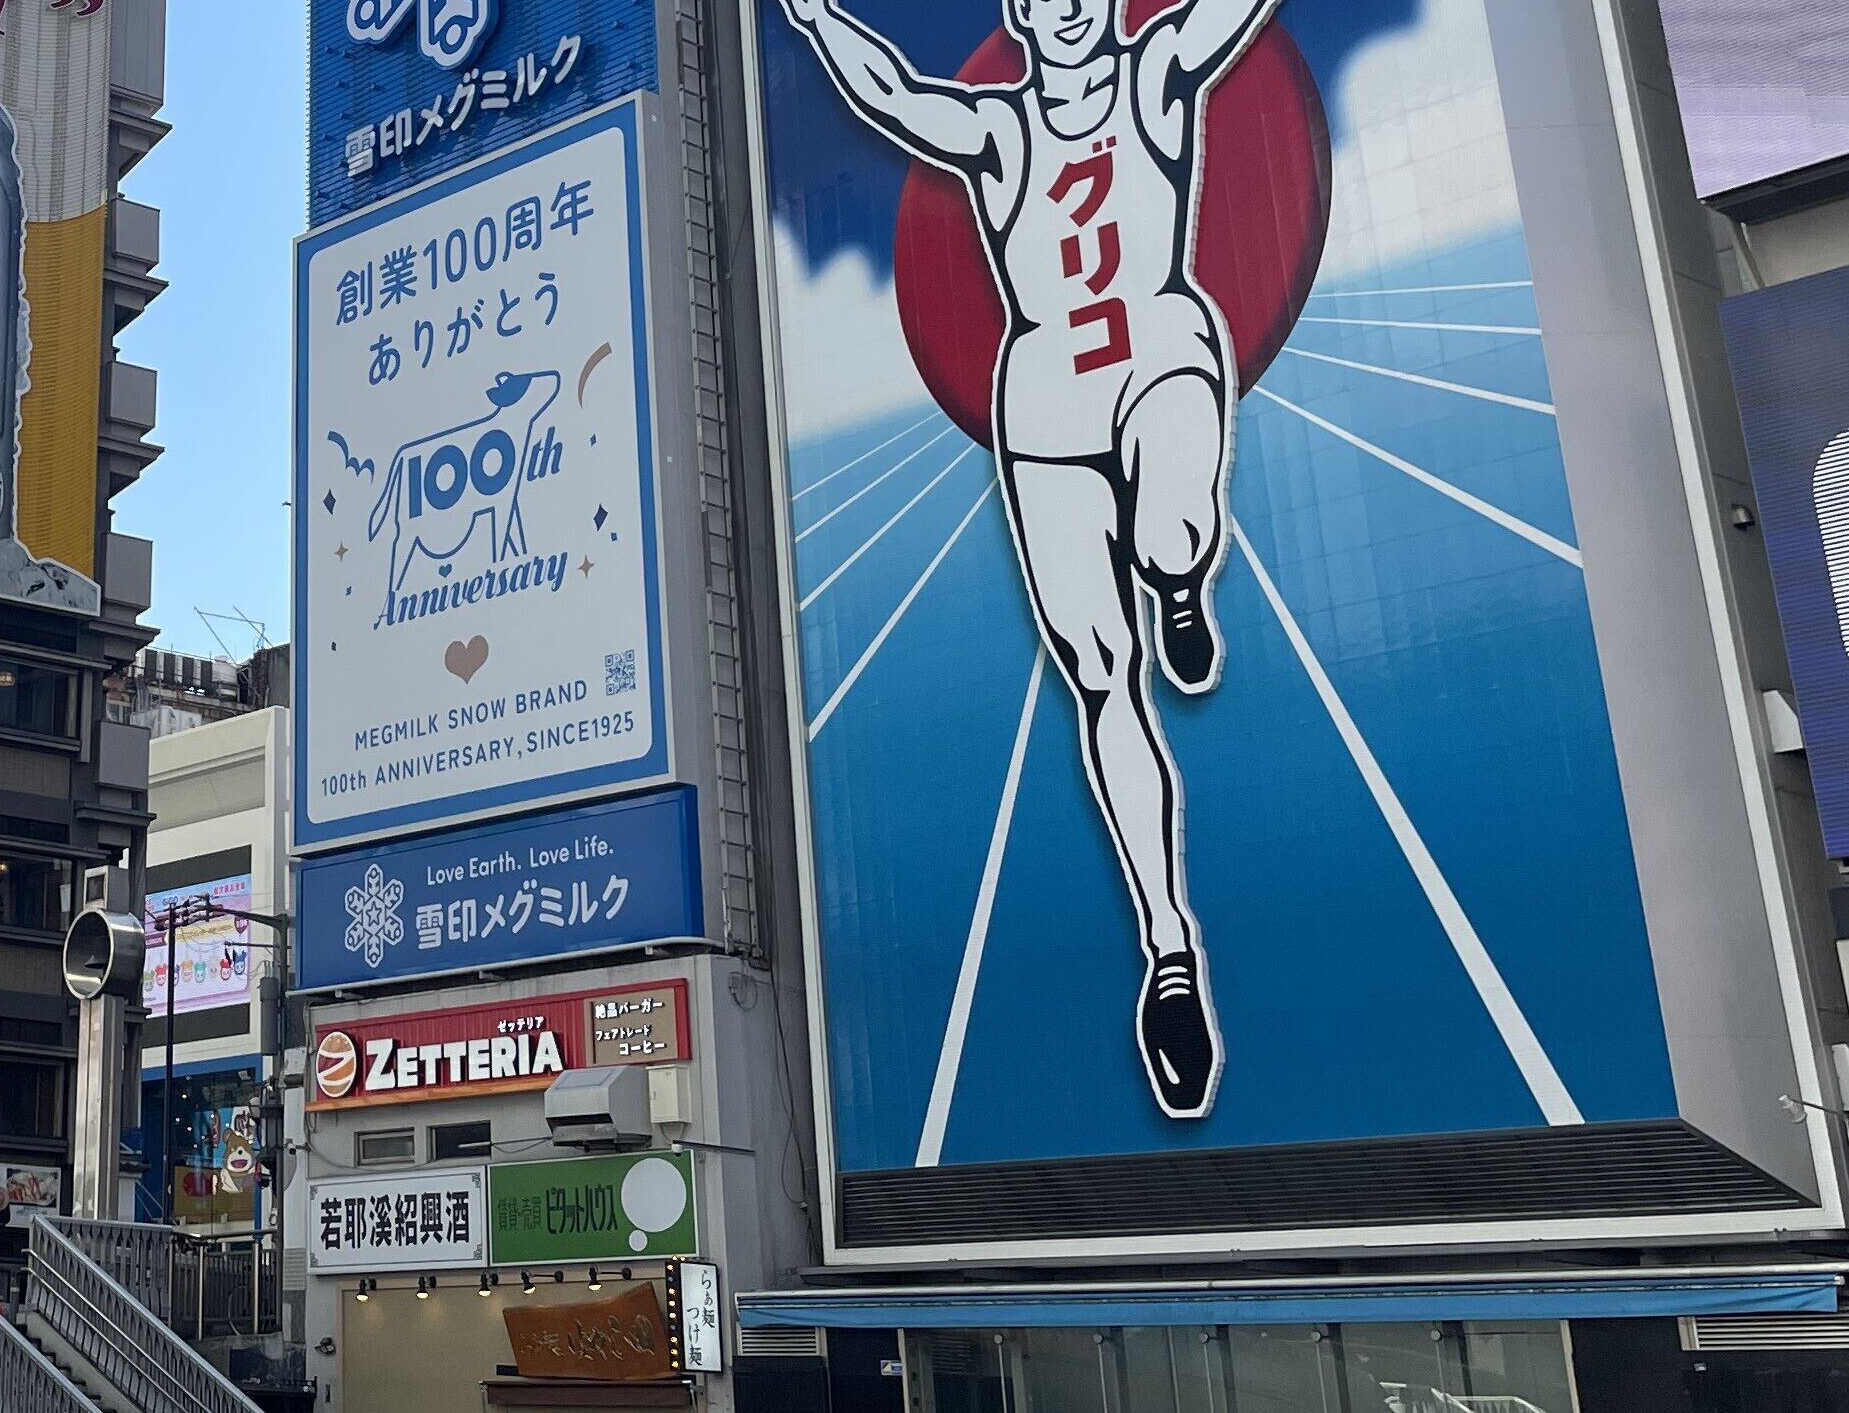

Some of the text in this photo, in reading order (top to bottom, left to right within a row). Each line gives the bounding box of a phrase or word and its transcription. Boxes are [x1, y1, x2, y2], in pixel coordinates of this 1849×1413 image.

[345, 34, 582, 178] 雪印メグミルク
[335, 179, 594, 326] 創業100周年
[1046, 135, 1133, 375] グリコ
[367, 271, 559, 385] ありがとう
[408, 426, 563, 519] 100th
[373, 551, 568, 631] Anniversary
[354, 679, 588, 752] MEGMILK SNOW BRAND
[322, 769, 367, 797] 100th
[427, 835, 614, 887] Love Earth. Love Life.
[415, 873, 630, 951] 雪印メグミルク
[497, 1015, 544, 1033] ゼッテリア
[595, 998, 664, 1019] 絶品バーガー
[596, 1024, 651, 1041] フェアトレード
[364, 1030, 564, 1092] ZETTERIA
[619, 1040, 666, 1055] コーヒー
[546, 1184, 618, 1234] ピタットハウス
[686, 1307, 703, 1367] つけ麺
